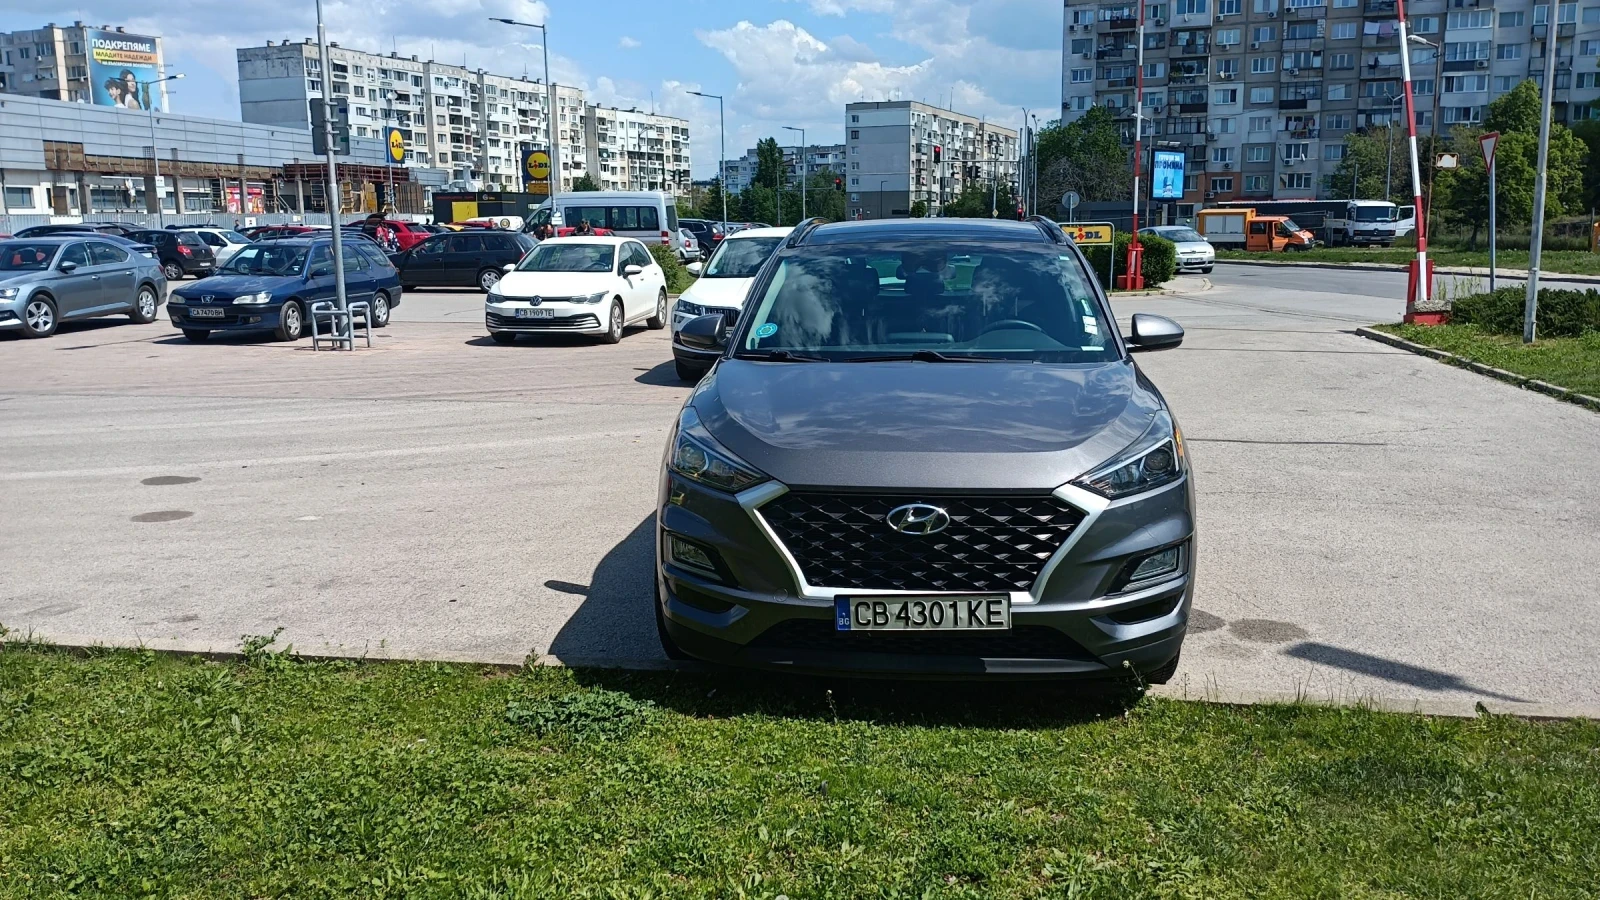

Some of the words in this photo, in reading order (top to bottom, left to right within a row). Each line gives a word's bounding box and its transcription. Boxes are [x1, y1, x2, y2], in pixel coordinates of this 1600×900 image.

[91, 38, 151, 52] ПОДКРЕПЯМЕ
[95, 51, 123, 59] МЛАДИТЕ
[124, 53, 152, 61] НАДЕЖДИ
[854, 601, 890, 627] CB
[895, 600, 960, 627] 4301
[967, 599, 1005, 626] KE
[838, 618, 850, 626] BG
